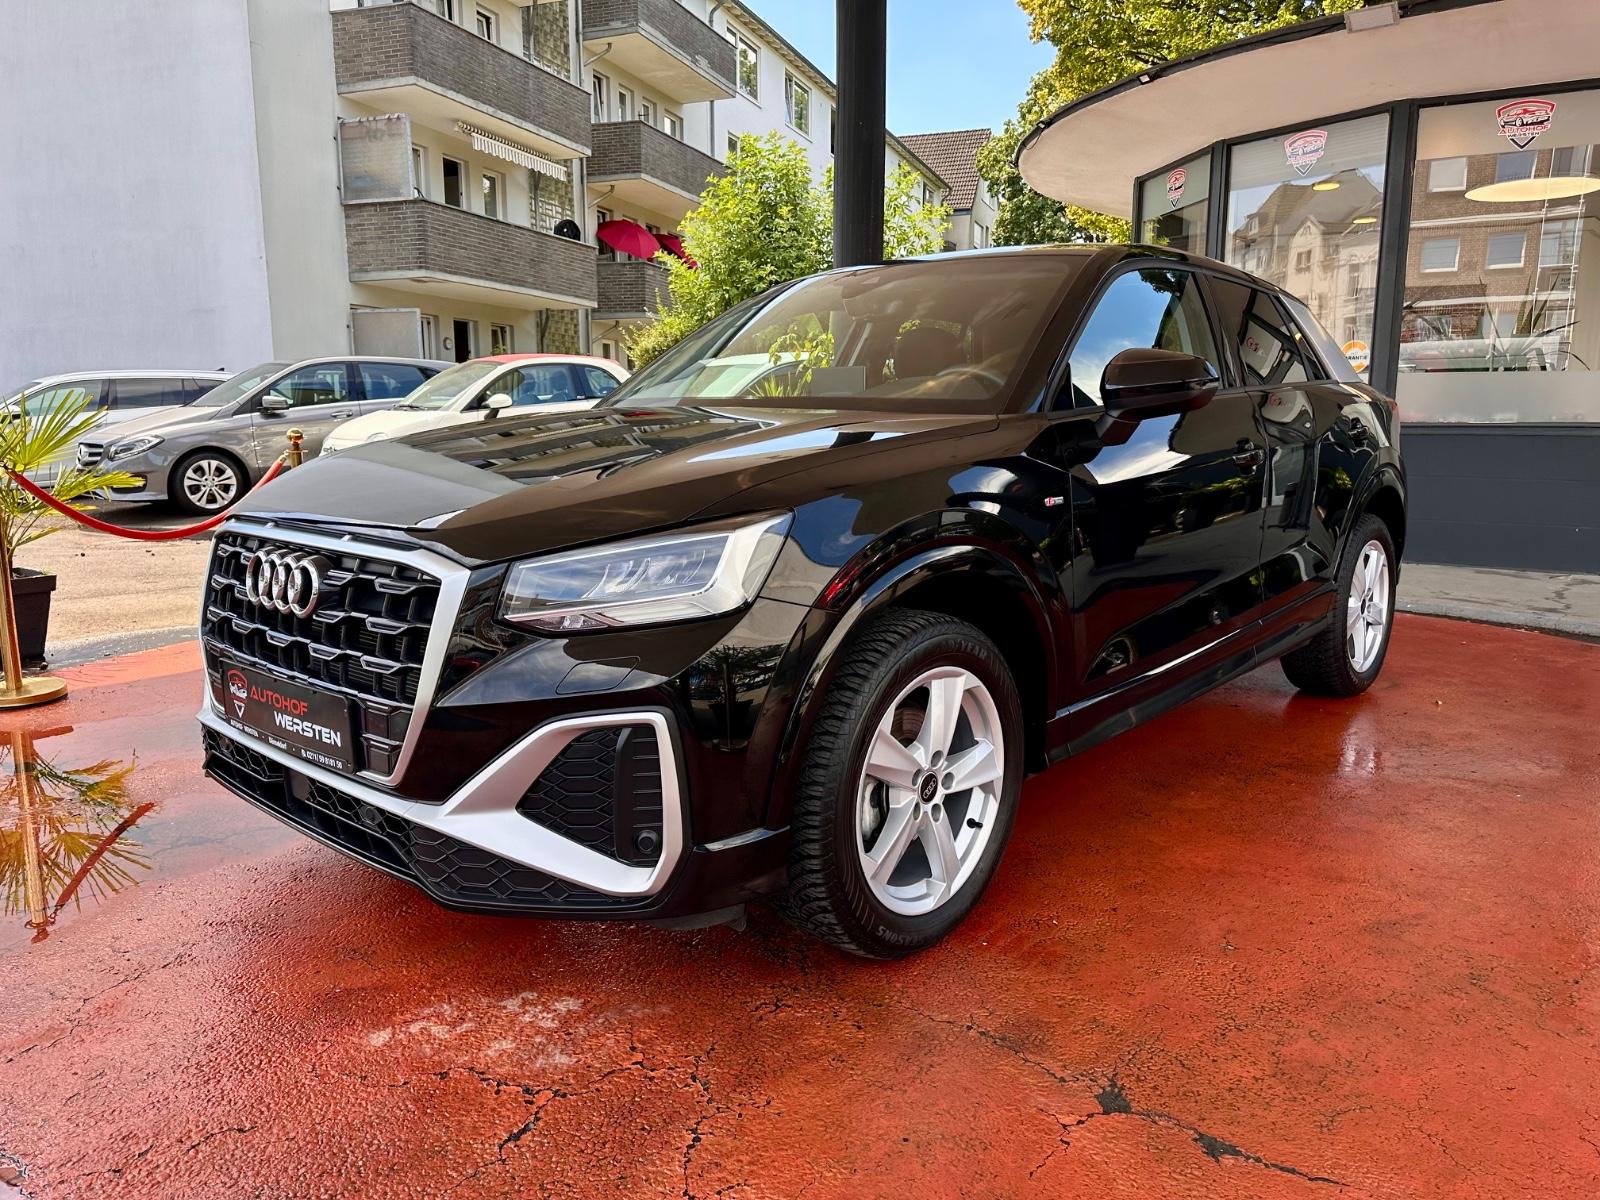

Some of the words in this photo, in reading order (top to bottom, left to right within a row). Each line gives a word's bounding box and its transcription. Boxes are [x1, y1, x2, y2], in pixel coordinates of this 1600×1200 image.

[1499, 124, 1549, 135] AUTOHOF
[250, 684, 308, 716] AUTOHOF
[273, 710, 341, 747] WERSTEN
